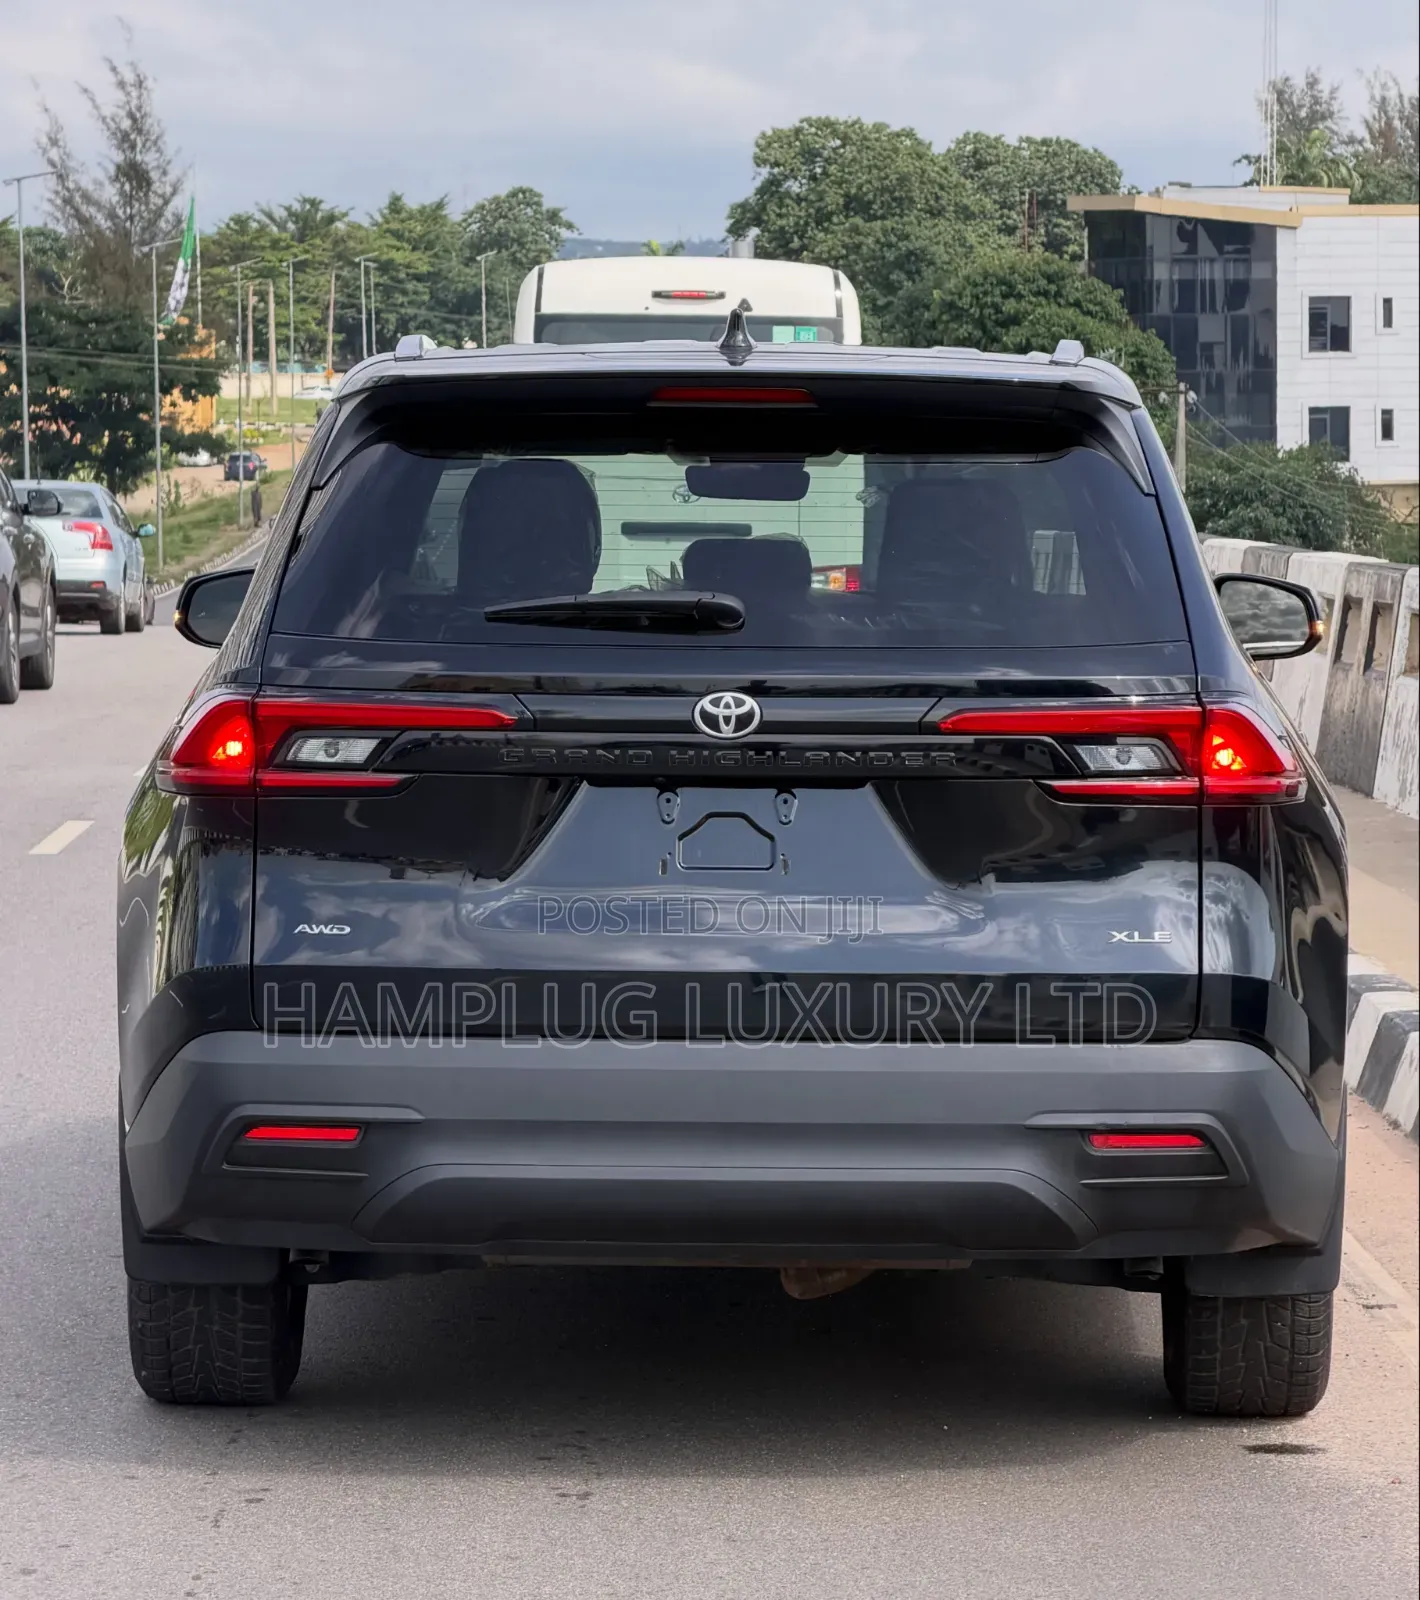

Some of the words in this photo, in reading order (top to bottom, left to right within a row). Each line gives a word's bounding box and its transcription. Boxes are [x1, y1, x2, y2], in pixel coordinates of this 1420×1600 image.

[499, 748, 653, 766] GRAND
[669, 750, 957, 768] HIGHLANDER
[293, 924, 351, 935] AWD
[1106, 930, 1173, 943] XLE
